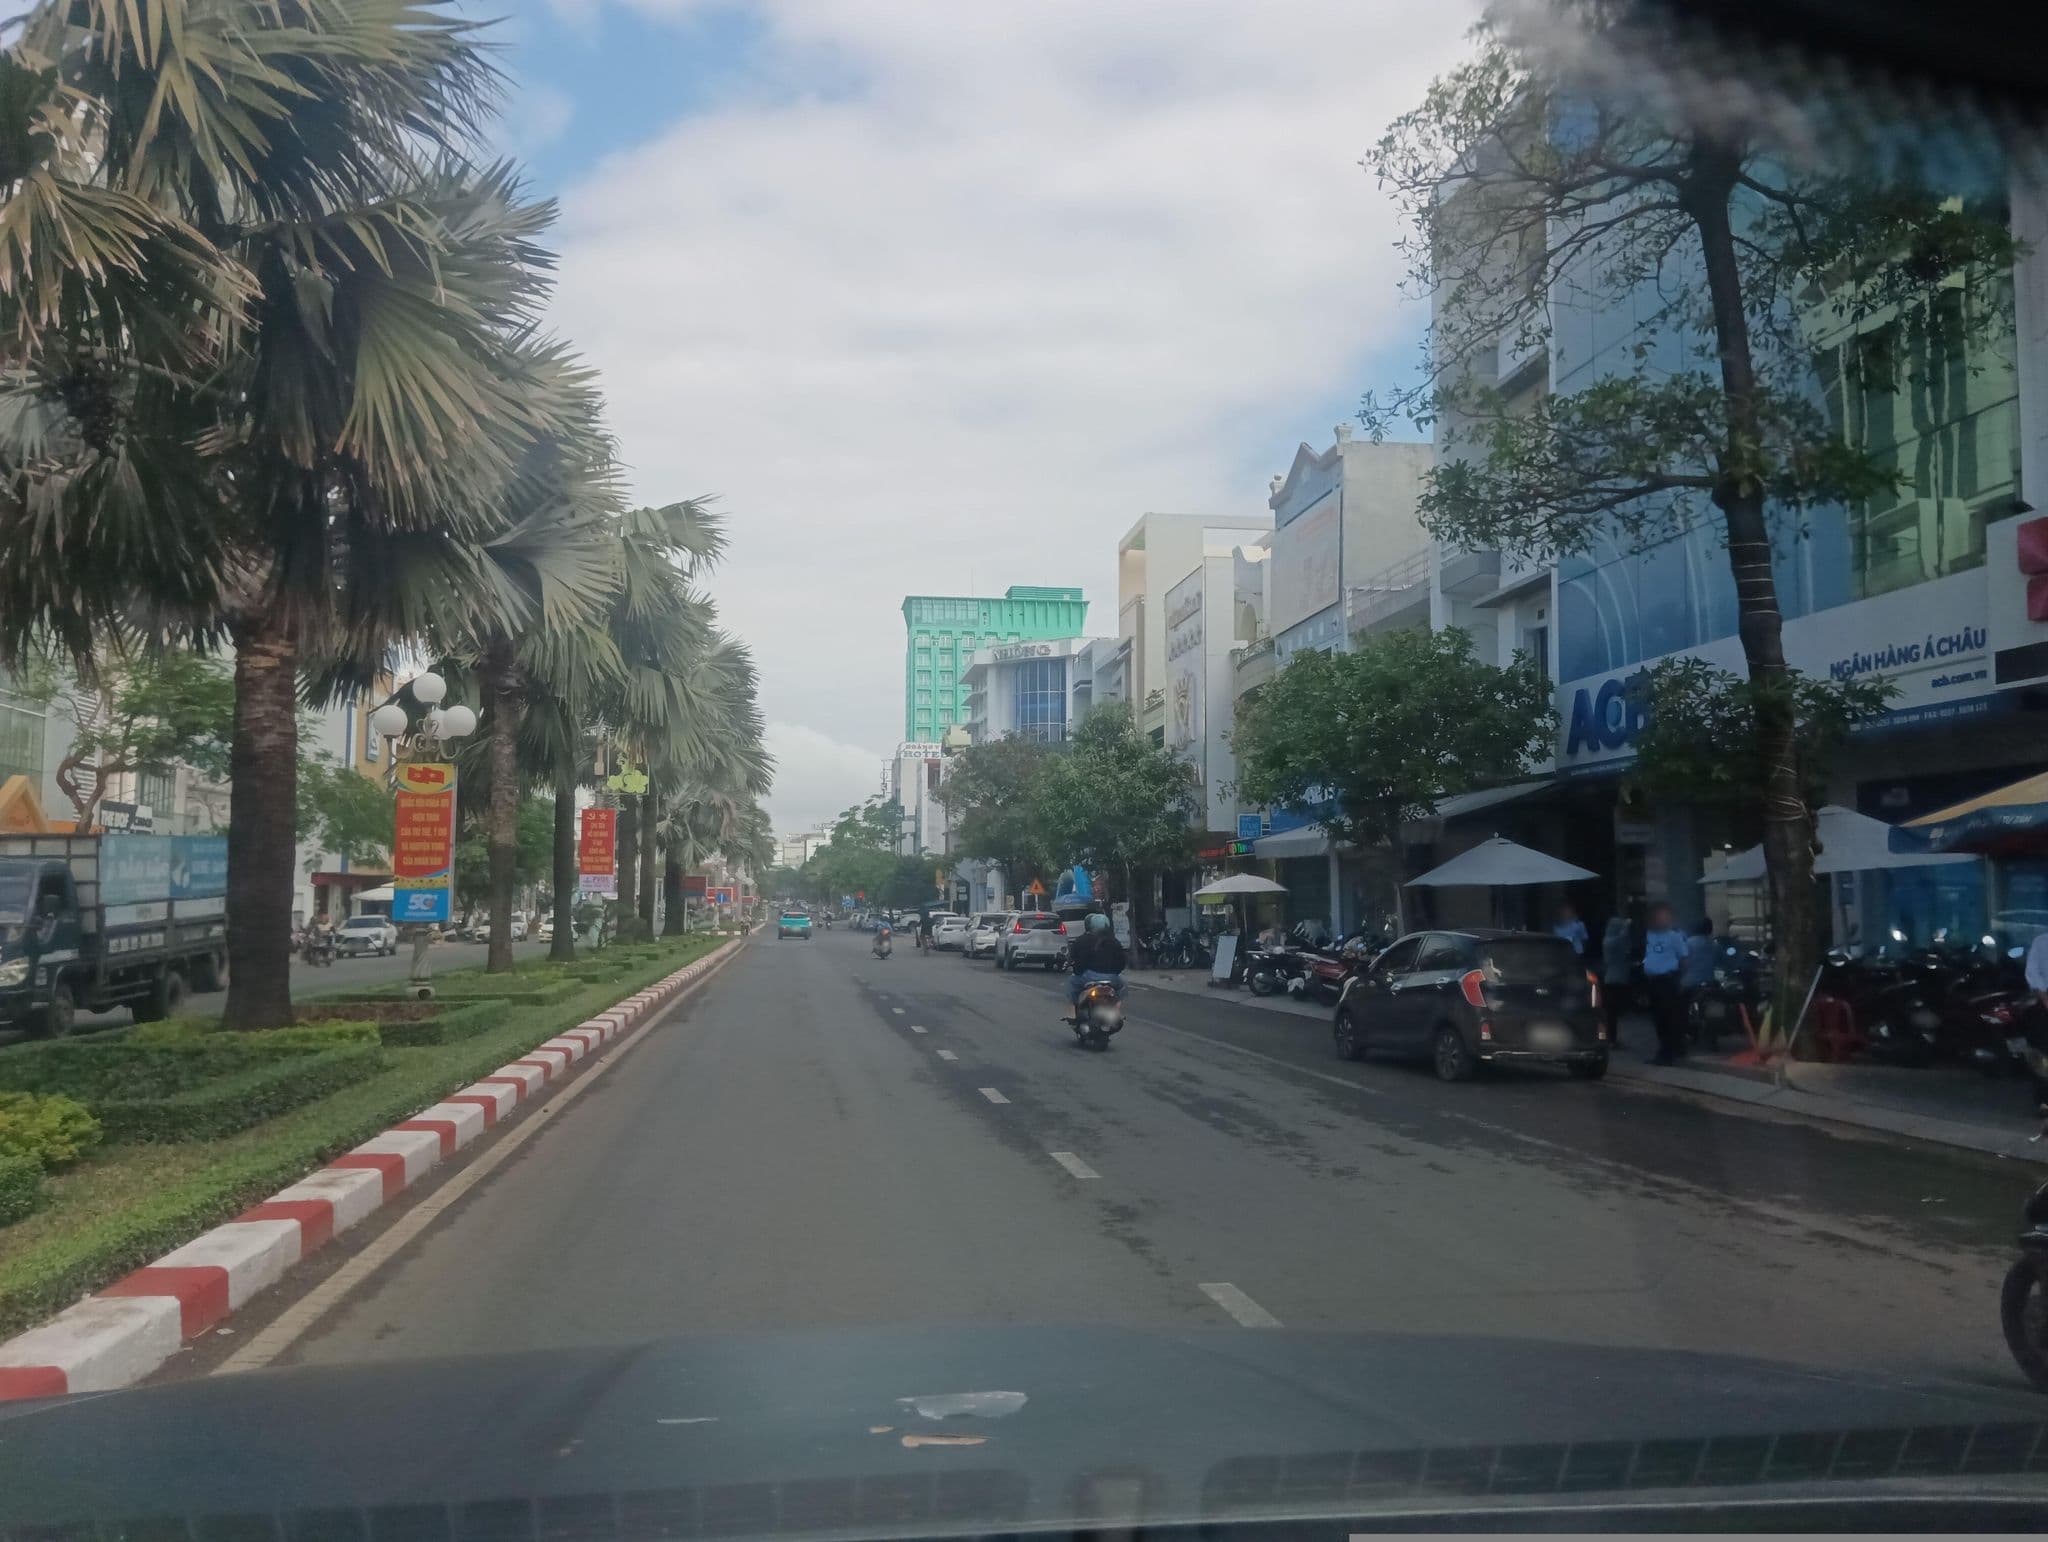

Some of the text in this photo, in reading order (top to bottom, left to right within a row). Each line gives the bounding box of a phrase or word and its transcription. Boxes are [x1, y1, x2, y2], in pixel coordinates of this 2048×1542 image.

[1829, 625, 1988, 680] NGÂN HÀNG Á CHÂU
[1930, 669, 1988, 688] acb.com.vn
